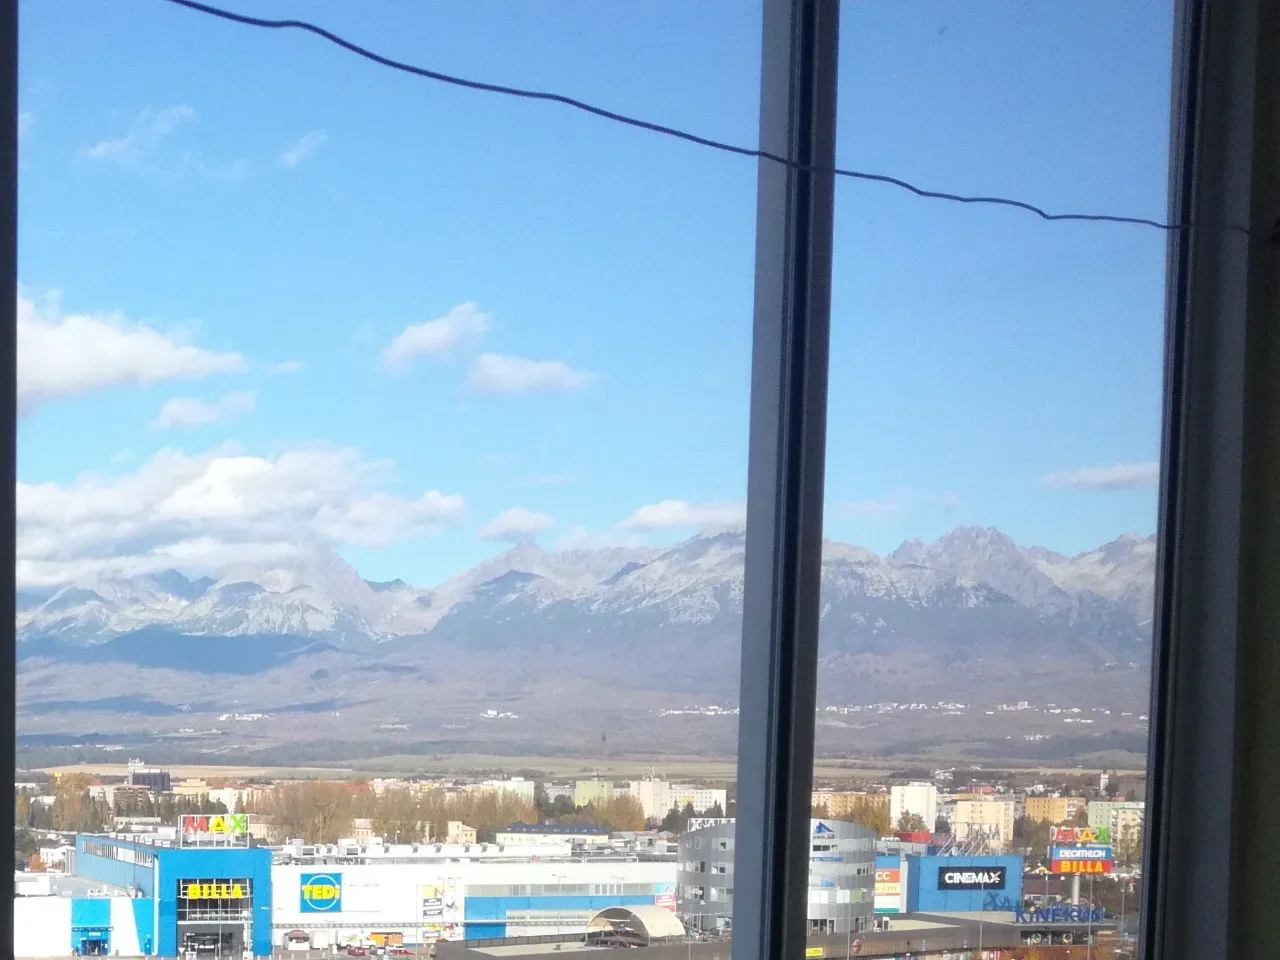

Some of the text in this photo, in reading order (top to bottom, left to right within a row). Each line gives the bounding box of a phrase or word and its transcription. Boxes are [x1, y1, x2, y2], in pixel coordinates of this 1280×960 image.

[184, 815, 246, 834] MAX
[1055, 826, 1109, 842] MAX
[1059, 849, 1106, 858] DECATHLON
[1060, 860, 1104, 873] BILLA
[944, 870, 1002, 884] CINEMAX
[187, 883, 244, 900] BILLA
